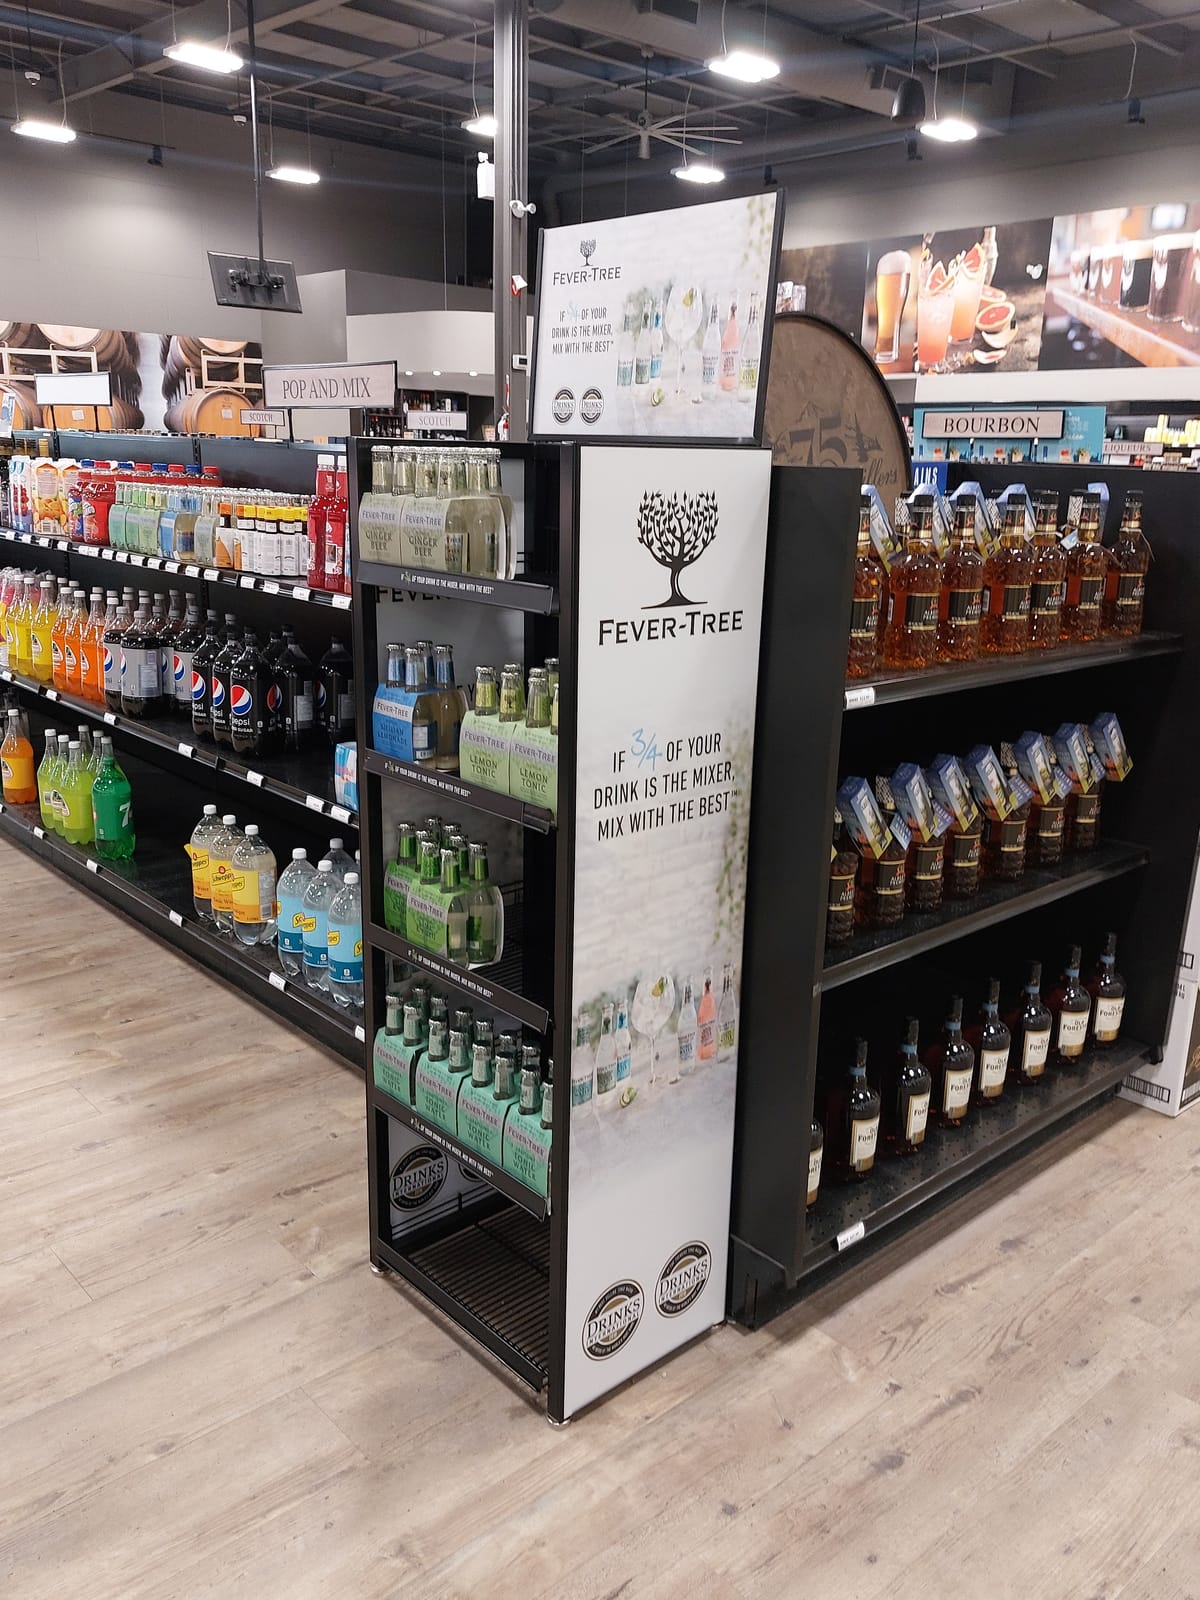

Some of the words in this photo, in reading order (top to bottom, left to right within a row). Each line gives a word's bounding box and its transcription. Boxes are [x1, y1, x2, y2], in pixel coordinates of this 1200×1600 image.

[581, 308, 589, 320] OF
[591, 307, 607, 319] YOUR
[551, 326, 570, 338] DRINK
[571, 326, 577, 338] IS
[579, 325, 591, 337] THE
[592, 323, 613, 336] MIXER,
[552, 343, 563, 354] MIX
[564, 342, 580, 354] WITH
[582, 341, 592, 353] THE
[283, 379, 306, 399] POP
[310, 378, 338, 399] AND
[343, 377, 371, 398] MIX
[249, 412, 273, 422] SCOTCH
[418, 415, 452, 427] SCOTCH
[944, 416, 1041, 434] BOURBON
[365, 530, 392, 541] GINGER
[408, 535, 438, 548] GINGER
[370, 540, 388, 551] BEER
[414, 546, 433, 557] BEER
[613, 751, 626, 773] IF
[630, 728, 663, 771] 3/4
[666, 739, 683, 762] OF
[688, 733, 721, 758] YOUR
[469, 754, 498, 769] LEMON
[471, 764, 496, 778] TONIC
[519, 767, 548, 784] LEMON
[521, 778, 546, 793] TONIC
[594, 780, 639, 809] DRINK
[644, 777, 657, 799] IS
[663, 770, 688, 794] THE
[693, 761, 735, 788] MIXER,
[598, 816, 624, 841] MIX
[630, 806, 664, 833] WITH
[670, 799, 694, 824] THE
[425, 1103, 446, 1121] WATER
[426, 1095, 446, 1113] TONIC
[467, 1130, 490, 1150] WATER
[468, 1123, 489, 1141] TONIC
[513, 1159, 536, 1180] WATER
[514, 1152, 535, 1172] TONIC
[393, 1161, 444, 1190] DRINKS
[661, 1259, 708, 1296] DRINKS
[588, 1297, 640, 1338] DRINKS
